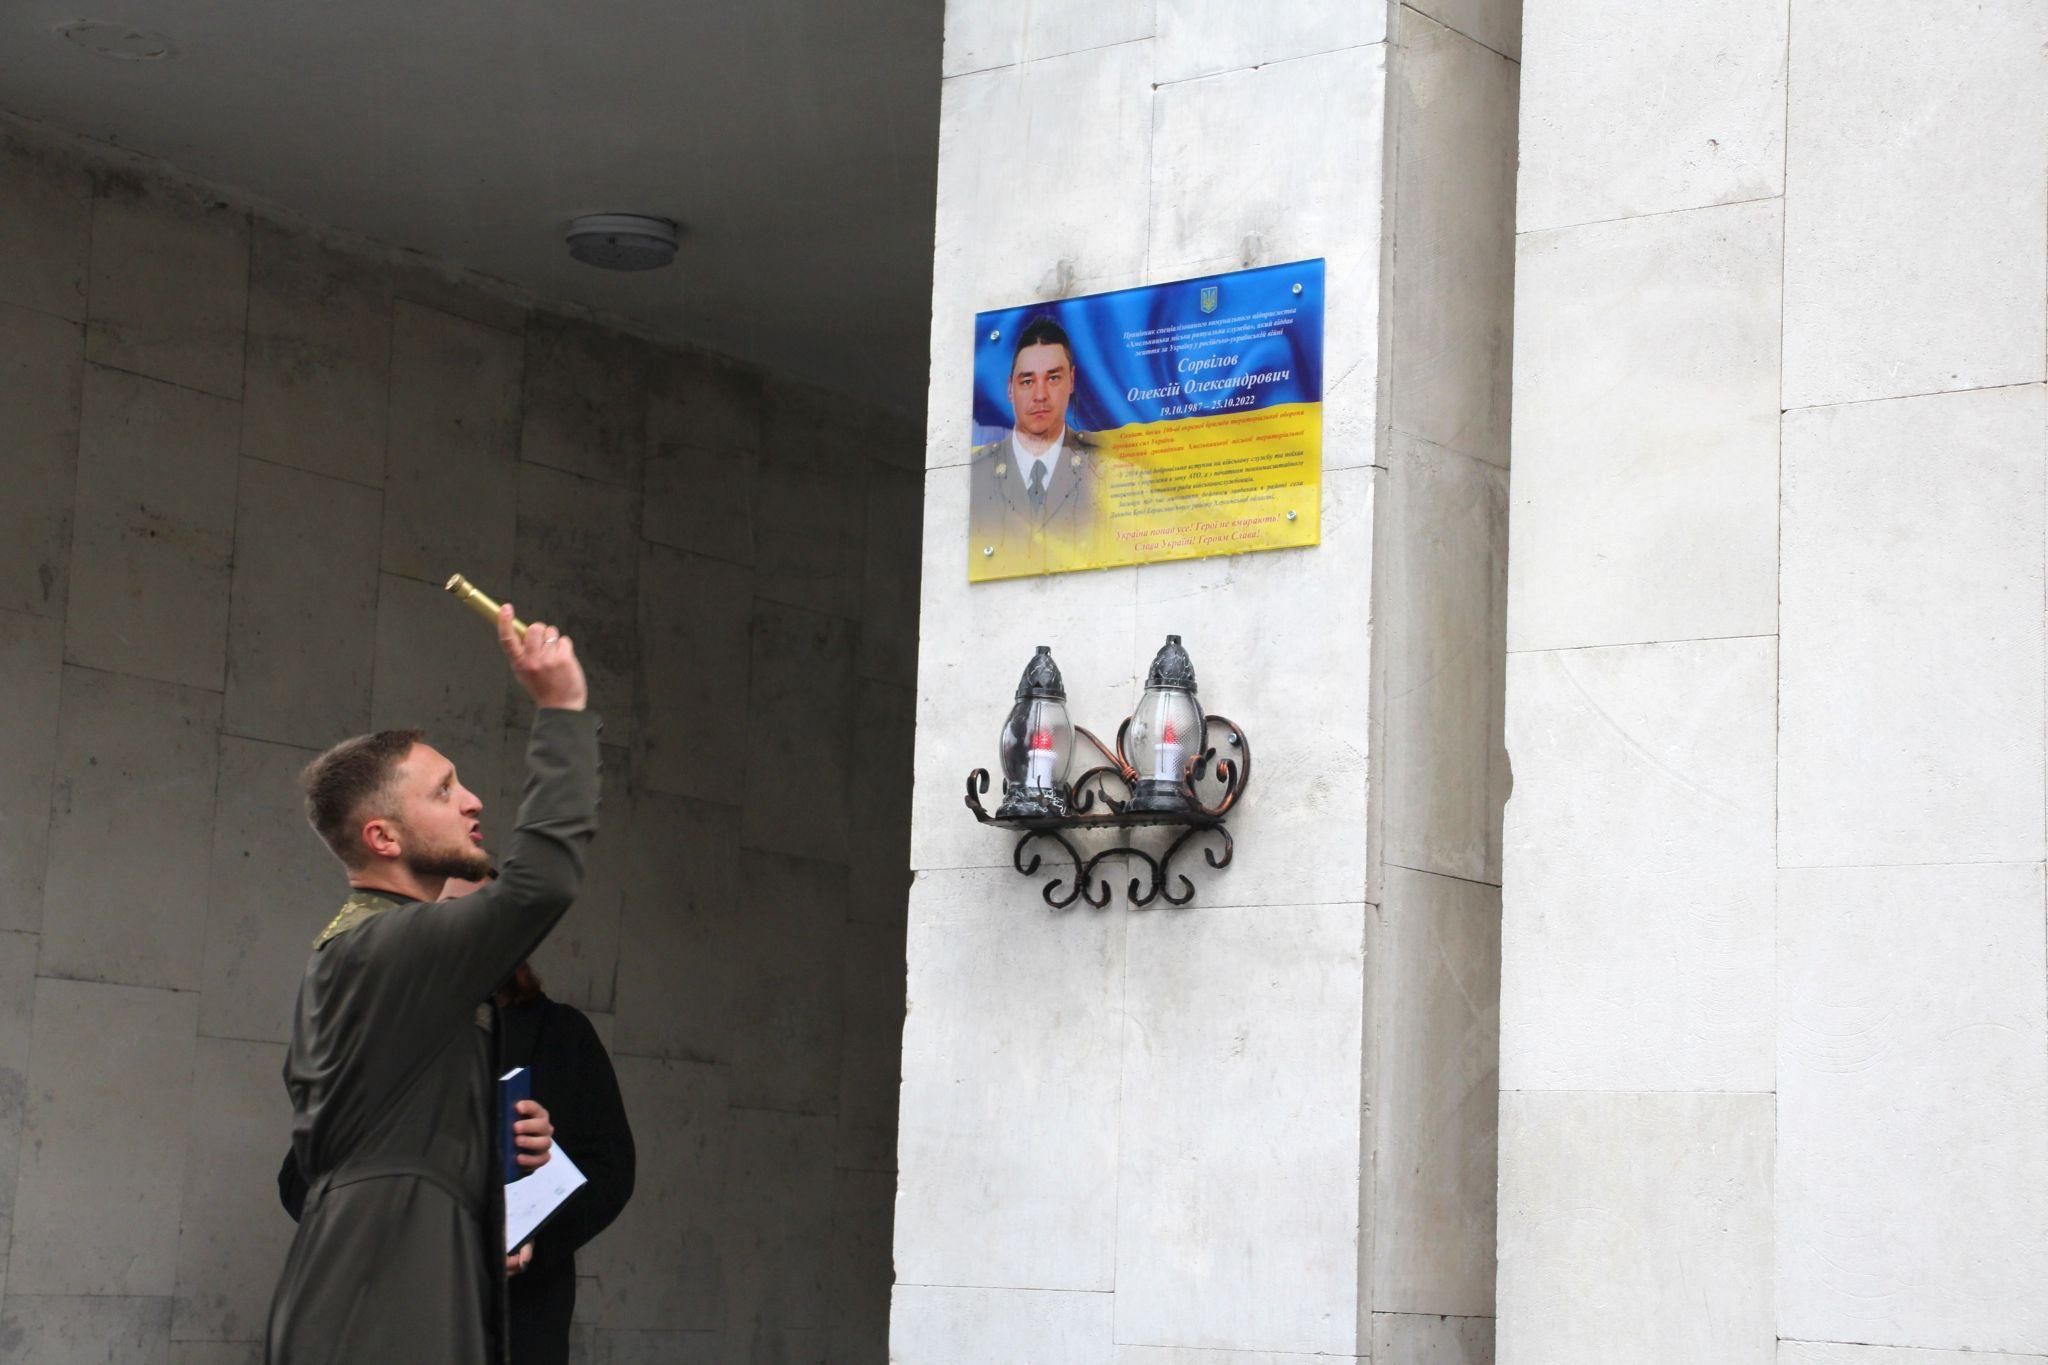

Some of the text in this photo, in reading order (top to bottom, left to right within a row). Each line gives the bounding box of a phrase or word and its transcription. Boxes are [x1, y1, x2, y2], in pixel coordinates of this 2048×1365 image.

[1178, 354, 1238, 375] Сорвілов
[1127, 370, 1289, 402] Олексій Олександрович
[1160, 402, 1202, 416] 19.10.1987
[1211, 395, 1255, 409] 25.10.2022
